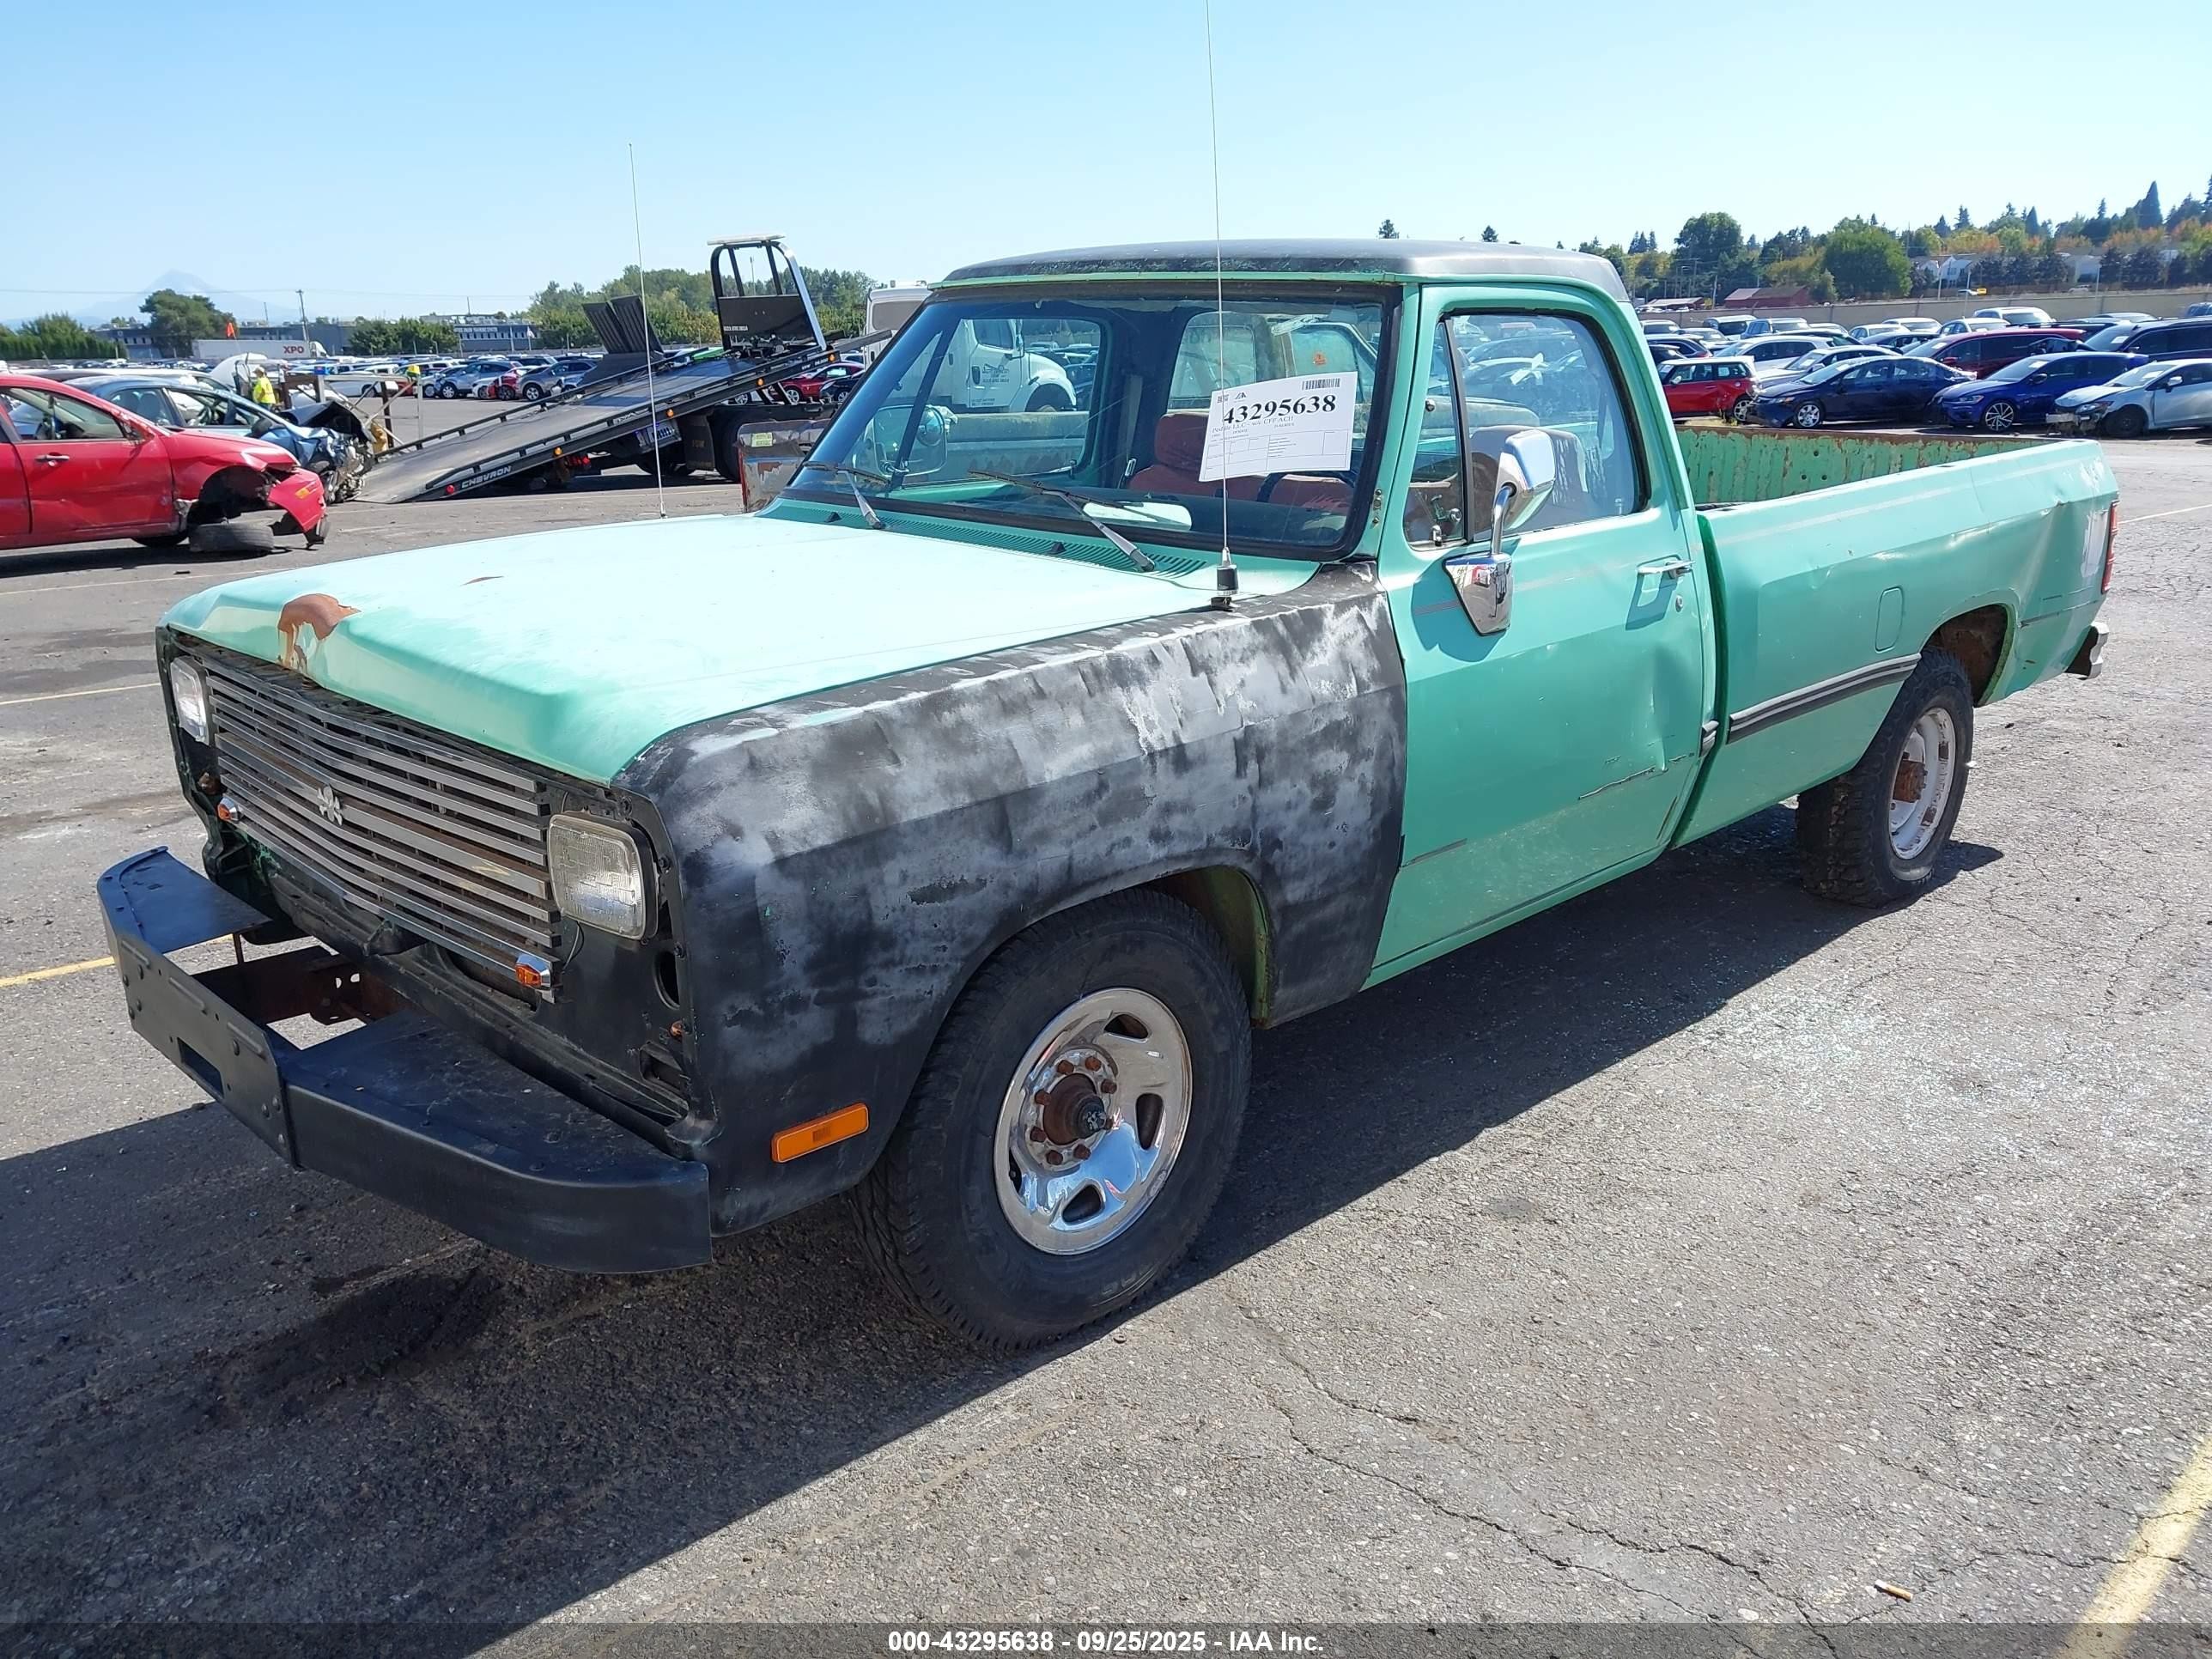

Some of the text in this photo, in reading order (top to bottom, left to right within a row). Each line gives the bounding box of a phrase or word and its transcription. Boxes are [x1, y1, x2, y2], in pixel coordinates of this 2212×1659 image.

[283, 345, 305, 354] XPO
[1224, 394, 1336, 424] 43295638
[461, 465, 512, 489] CHEVRON
